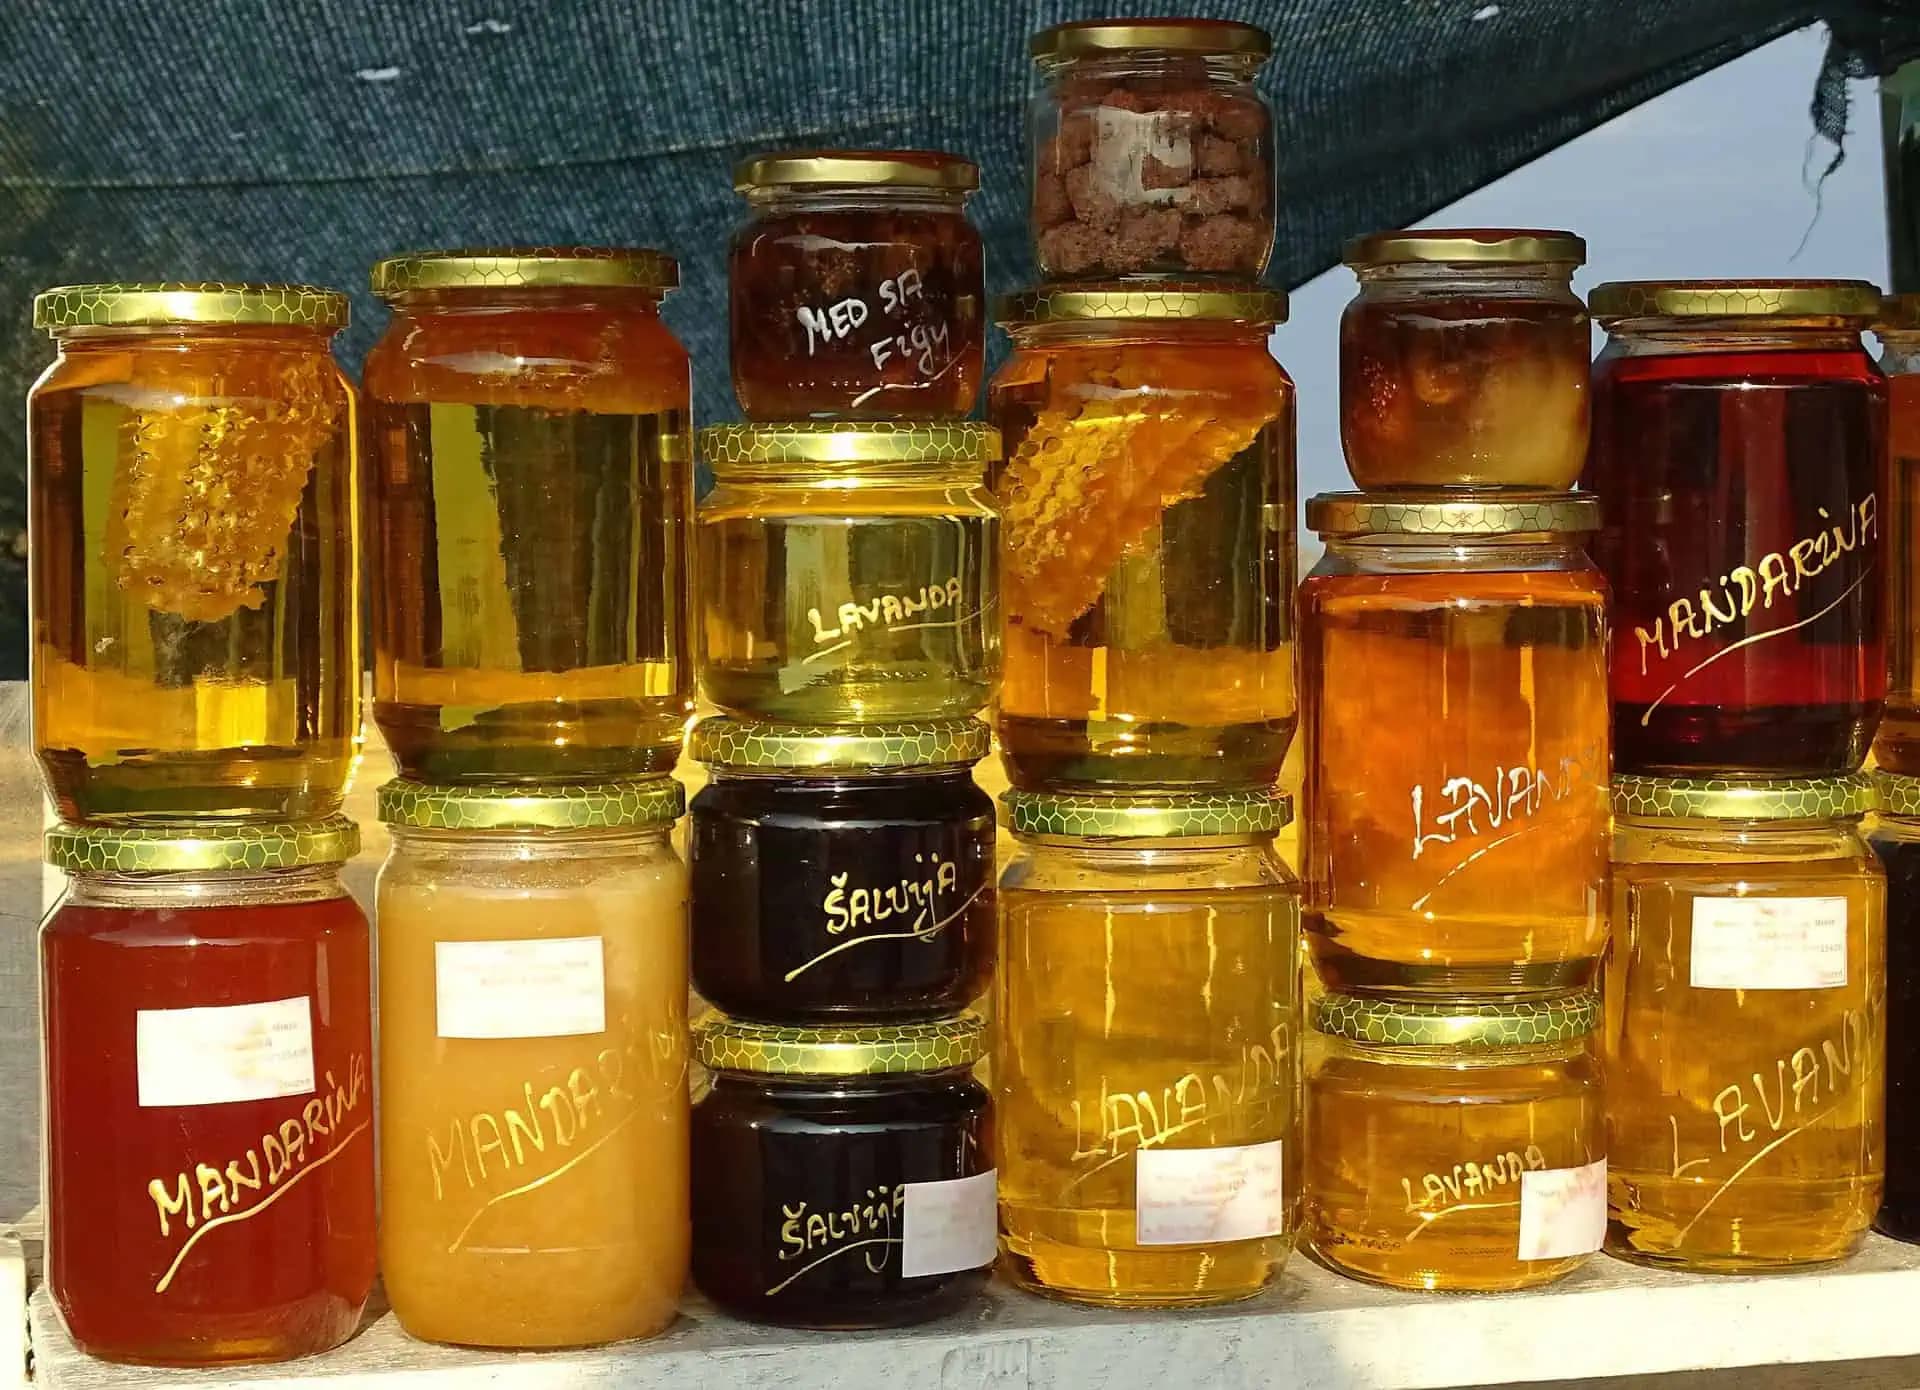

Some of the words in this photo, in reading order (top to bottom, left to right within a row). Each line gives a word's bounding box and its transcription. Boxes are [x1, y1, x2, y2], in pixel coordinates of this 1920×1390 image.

[796, 297, 868, 357] MED
[879, 268, 923, 314] SA
[807, 576, 961, 643] LAVANDA
[1070, 1021, 1290, 1161] LAVANDA
[1401, 1145, 1547, 1214] LAVANDA
